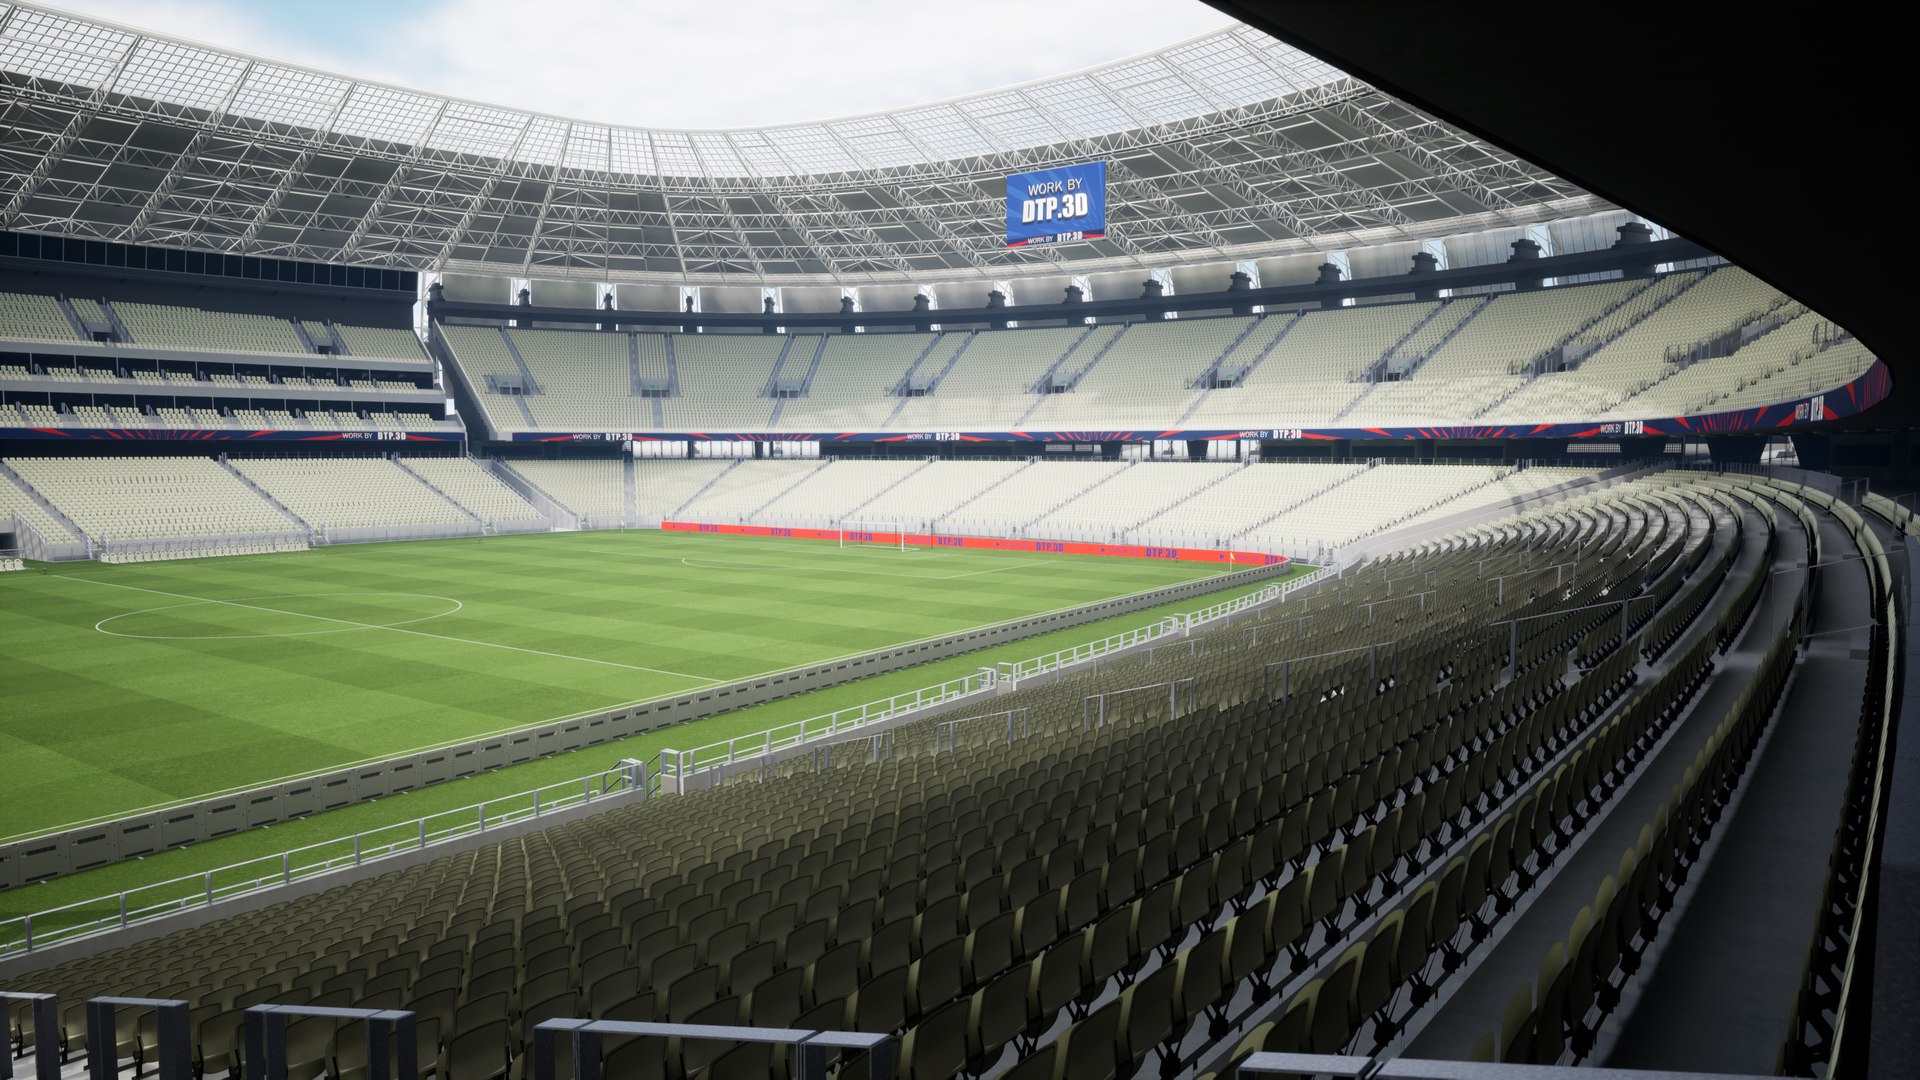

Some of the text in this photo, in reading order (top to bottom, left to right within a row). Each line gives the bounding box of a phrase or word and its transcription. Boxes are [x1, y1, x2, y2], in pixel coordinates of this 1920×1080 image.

[1028, 178, 1083, 197] WORK BY
[1022, 192, 1089, 223] DTP.3D
[1027, 236, 1045, 244] WORK
[1057, 231, 1083, 242] DTP.3D
[377, 431, 407, 440] DTP.3D
[605, 432, 633, 441] DTP.3D
[936, 432, 960, 441] DTP.3D
[1273, 429, 1302, 439] DTP.3D
